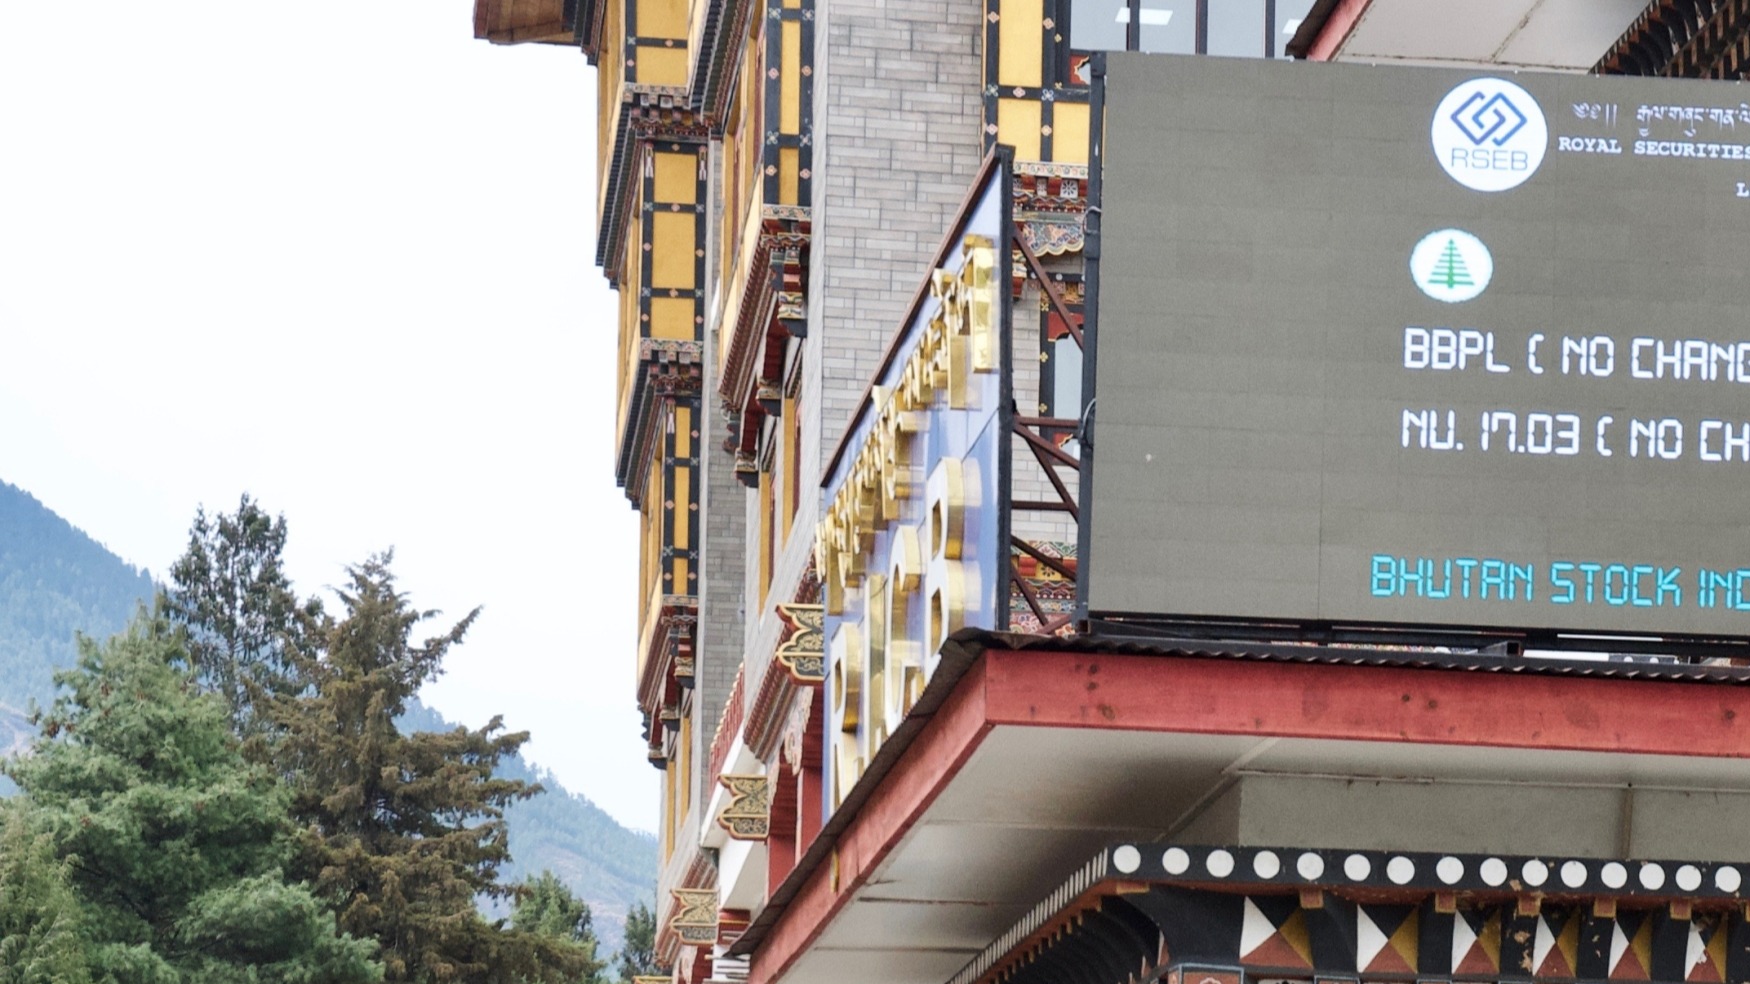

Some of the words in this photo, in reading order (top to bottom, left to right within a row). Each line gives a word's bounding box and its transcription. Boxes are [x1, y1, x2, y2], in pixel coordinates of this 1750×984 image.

[1451, 147, 1528, 171] RSEB
[1559, 137, 1621, 153] ROYAL
[1404, 328, 1510, 372] BBPL
[1562, 336, 1614, 376] NO
[1402, 410, 1463, 450] NU.
[1482, 412, 1579, 454] 17.03
[1630, 419, 1682, 459] NO
[1371, 554, 1534, 600] BHUTAN
[1549, 561, 1682, 607] STOCK
